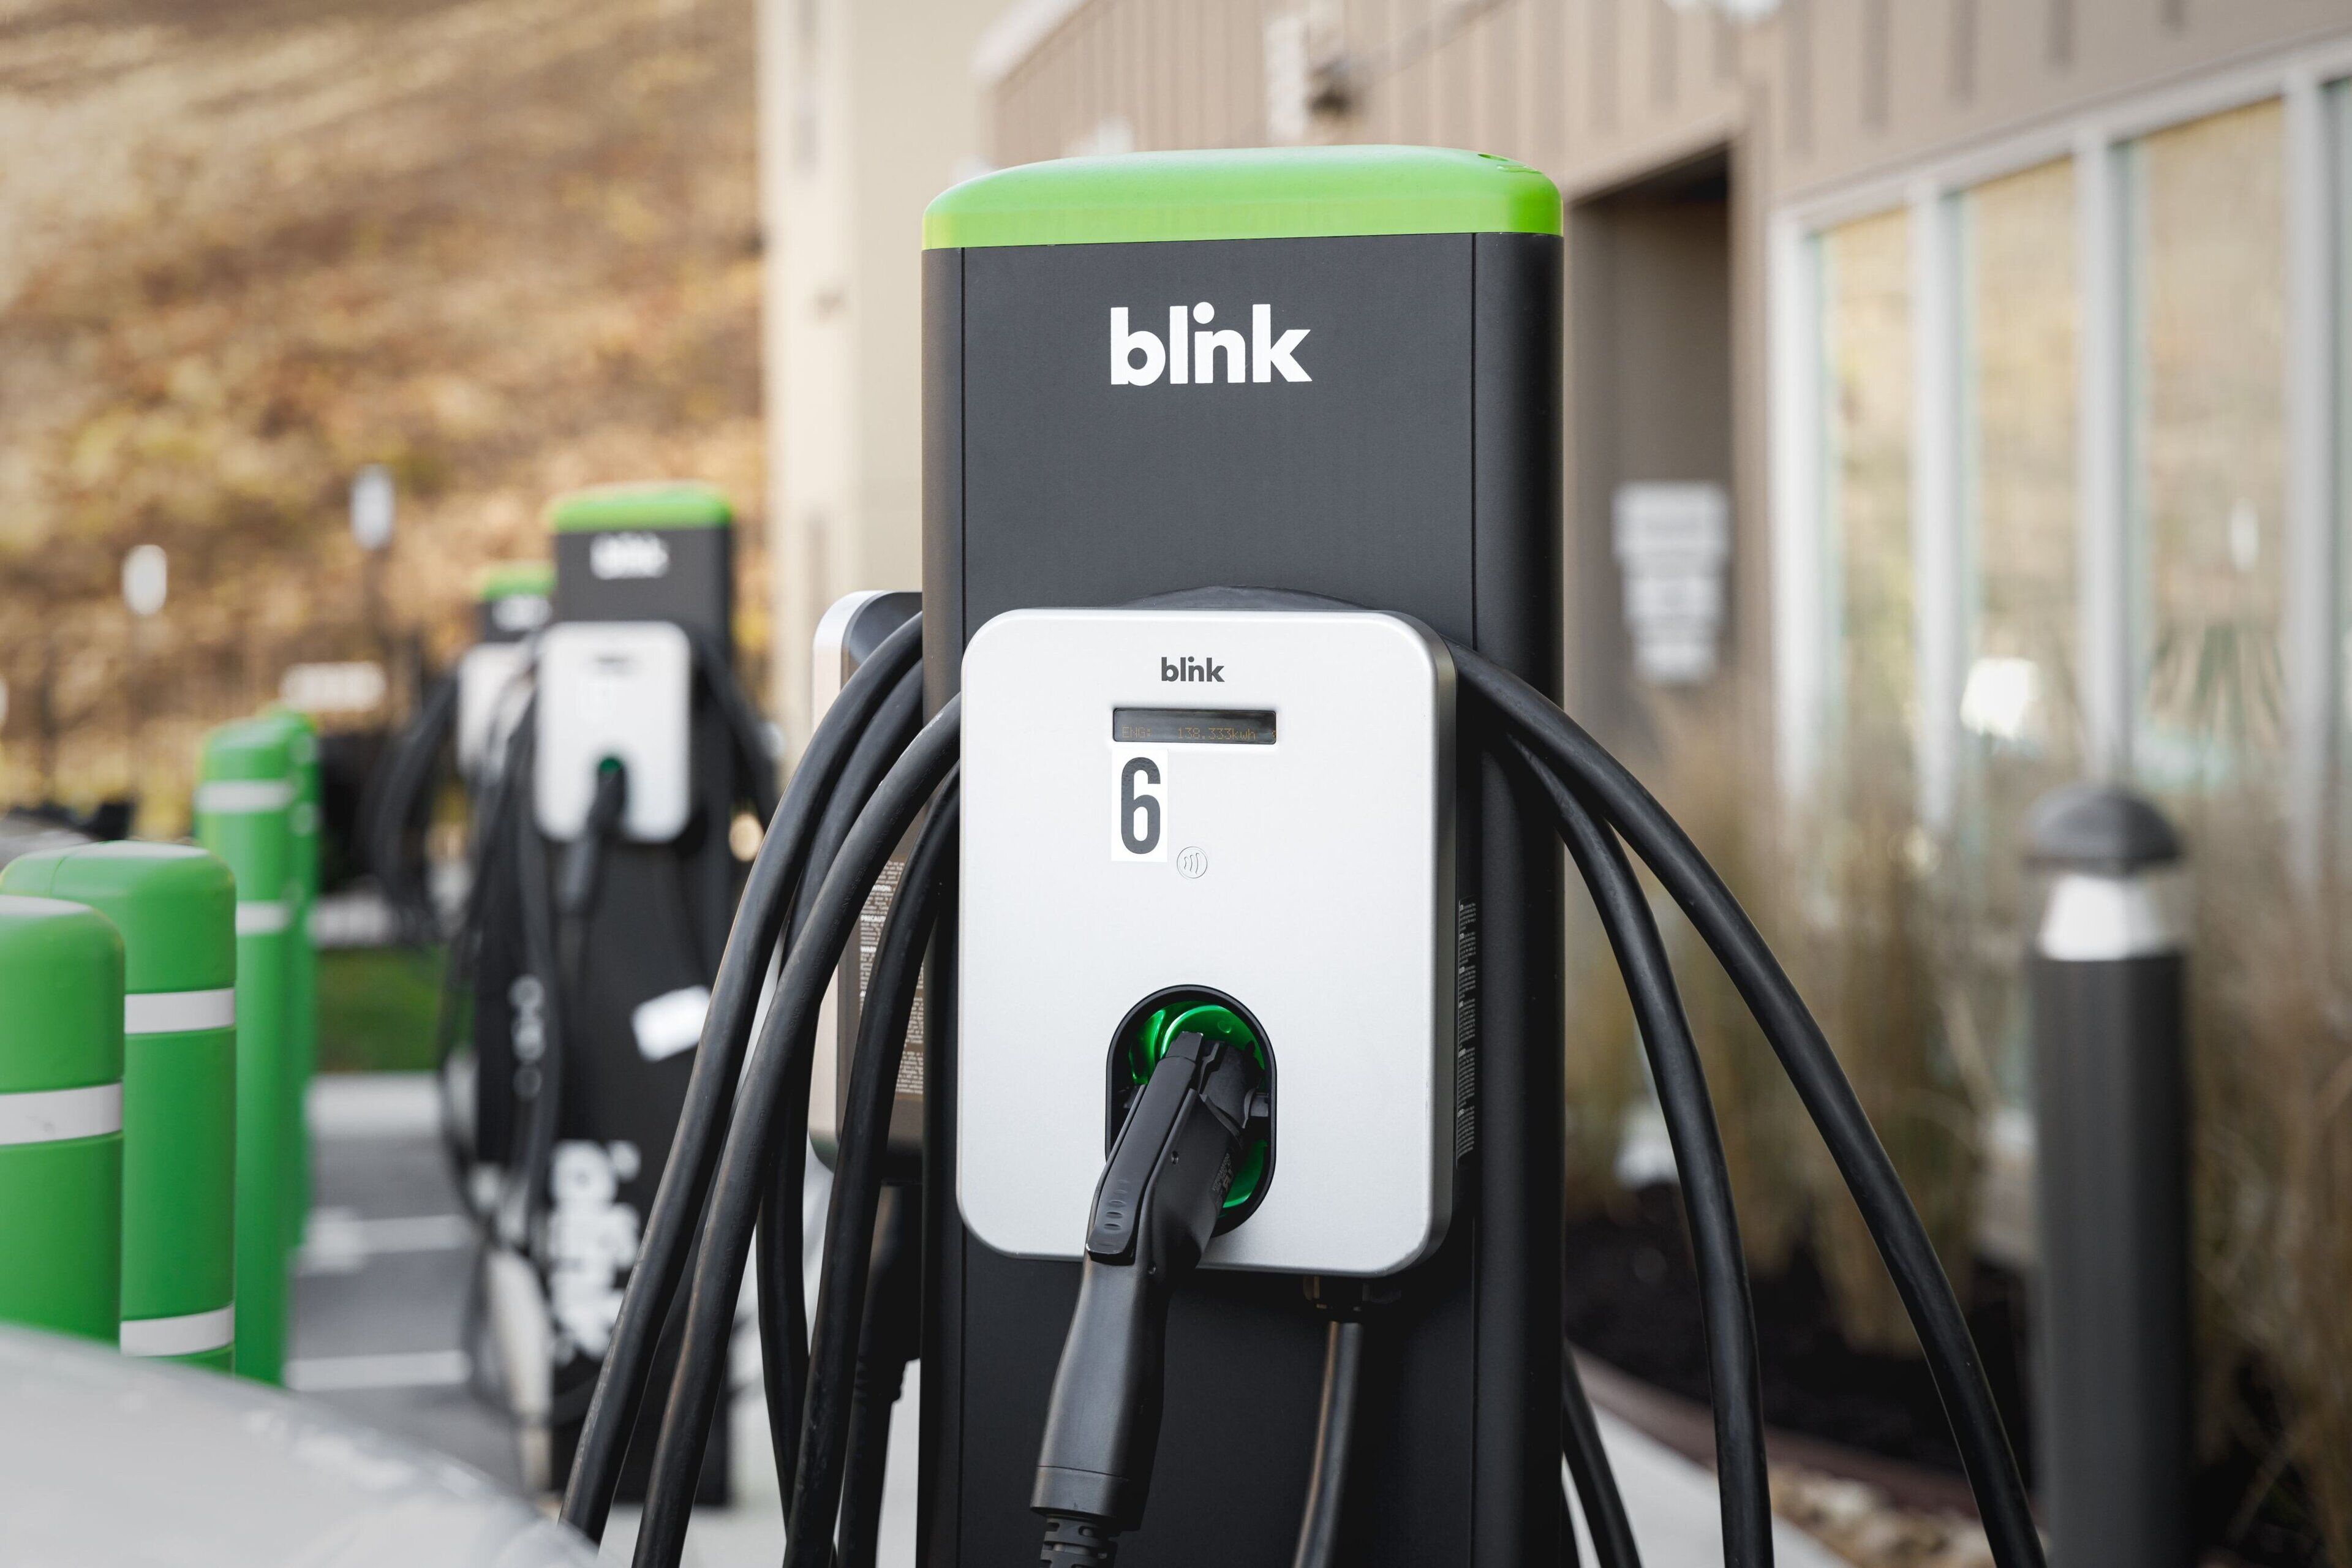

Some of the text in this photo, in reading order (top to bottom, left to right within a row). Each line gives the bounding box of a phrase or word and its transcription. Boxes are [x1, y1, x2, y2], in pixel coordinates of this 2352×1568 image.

[1110, 301, 1313, 386] blink
[1161, 656, 1225, 682] blink
[1121, 756, 1161, 854] 6
